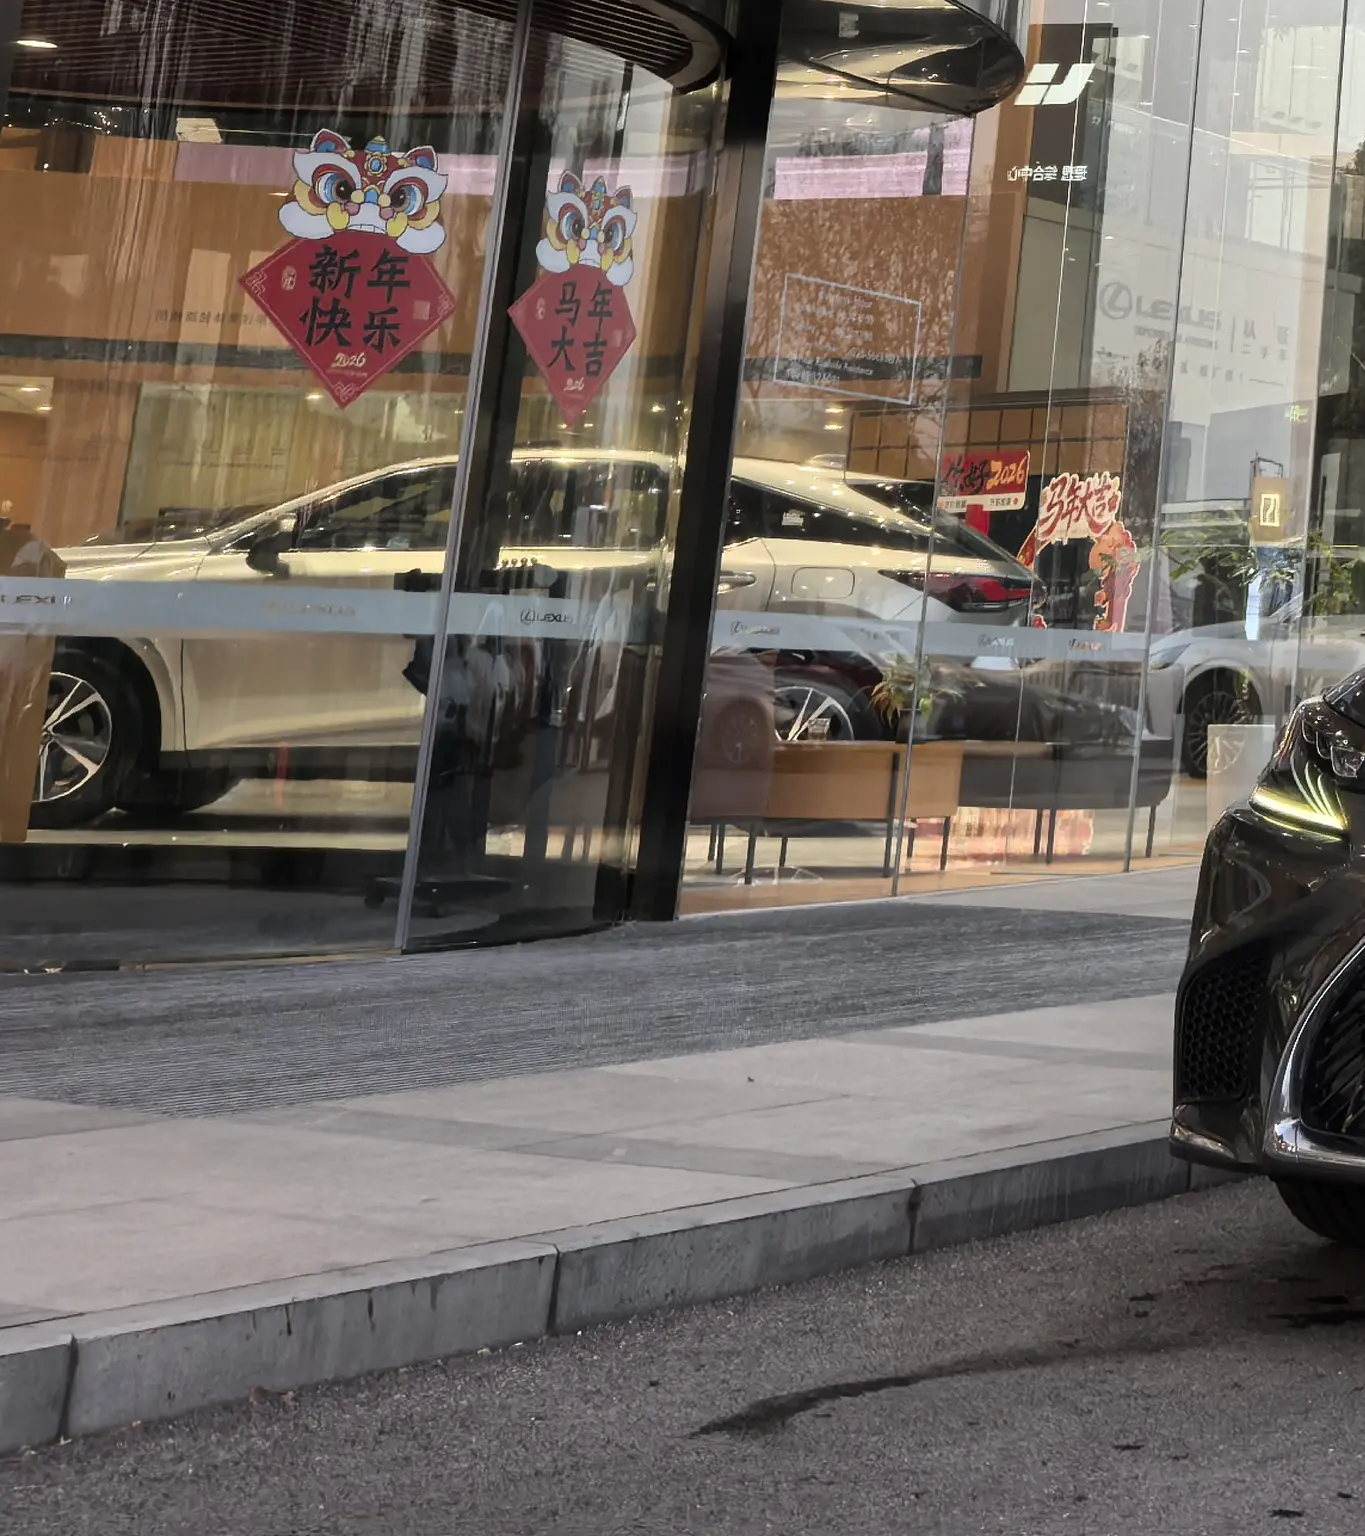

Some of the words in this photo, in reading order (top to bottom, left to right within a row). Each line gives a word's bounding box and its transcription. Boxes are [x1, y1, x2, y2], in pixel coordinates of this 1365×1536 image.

[308, 245, 411, 304] 新年
[299, 295, 402, 354] 快乐
[555, 281, 613, 332] 马年
[331, 352, 366, 368] 2026
[547, 325, 607, 377] 大吉
